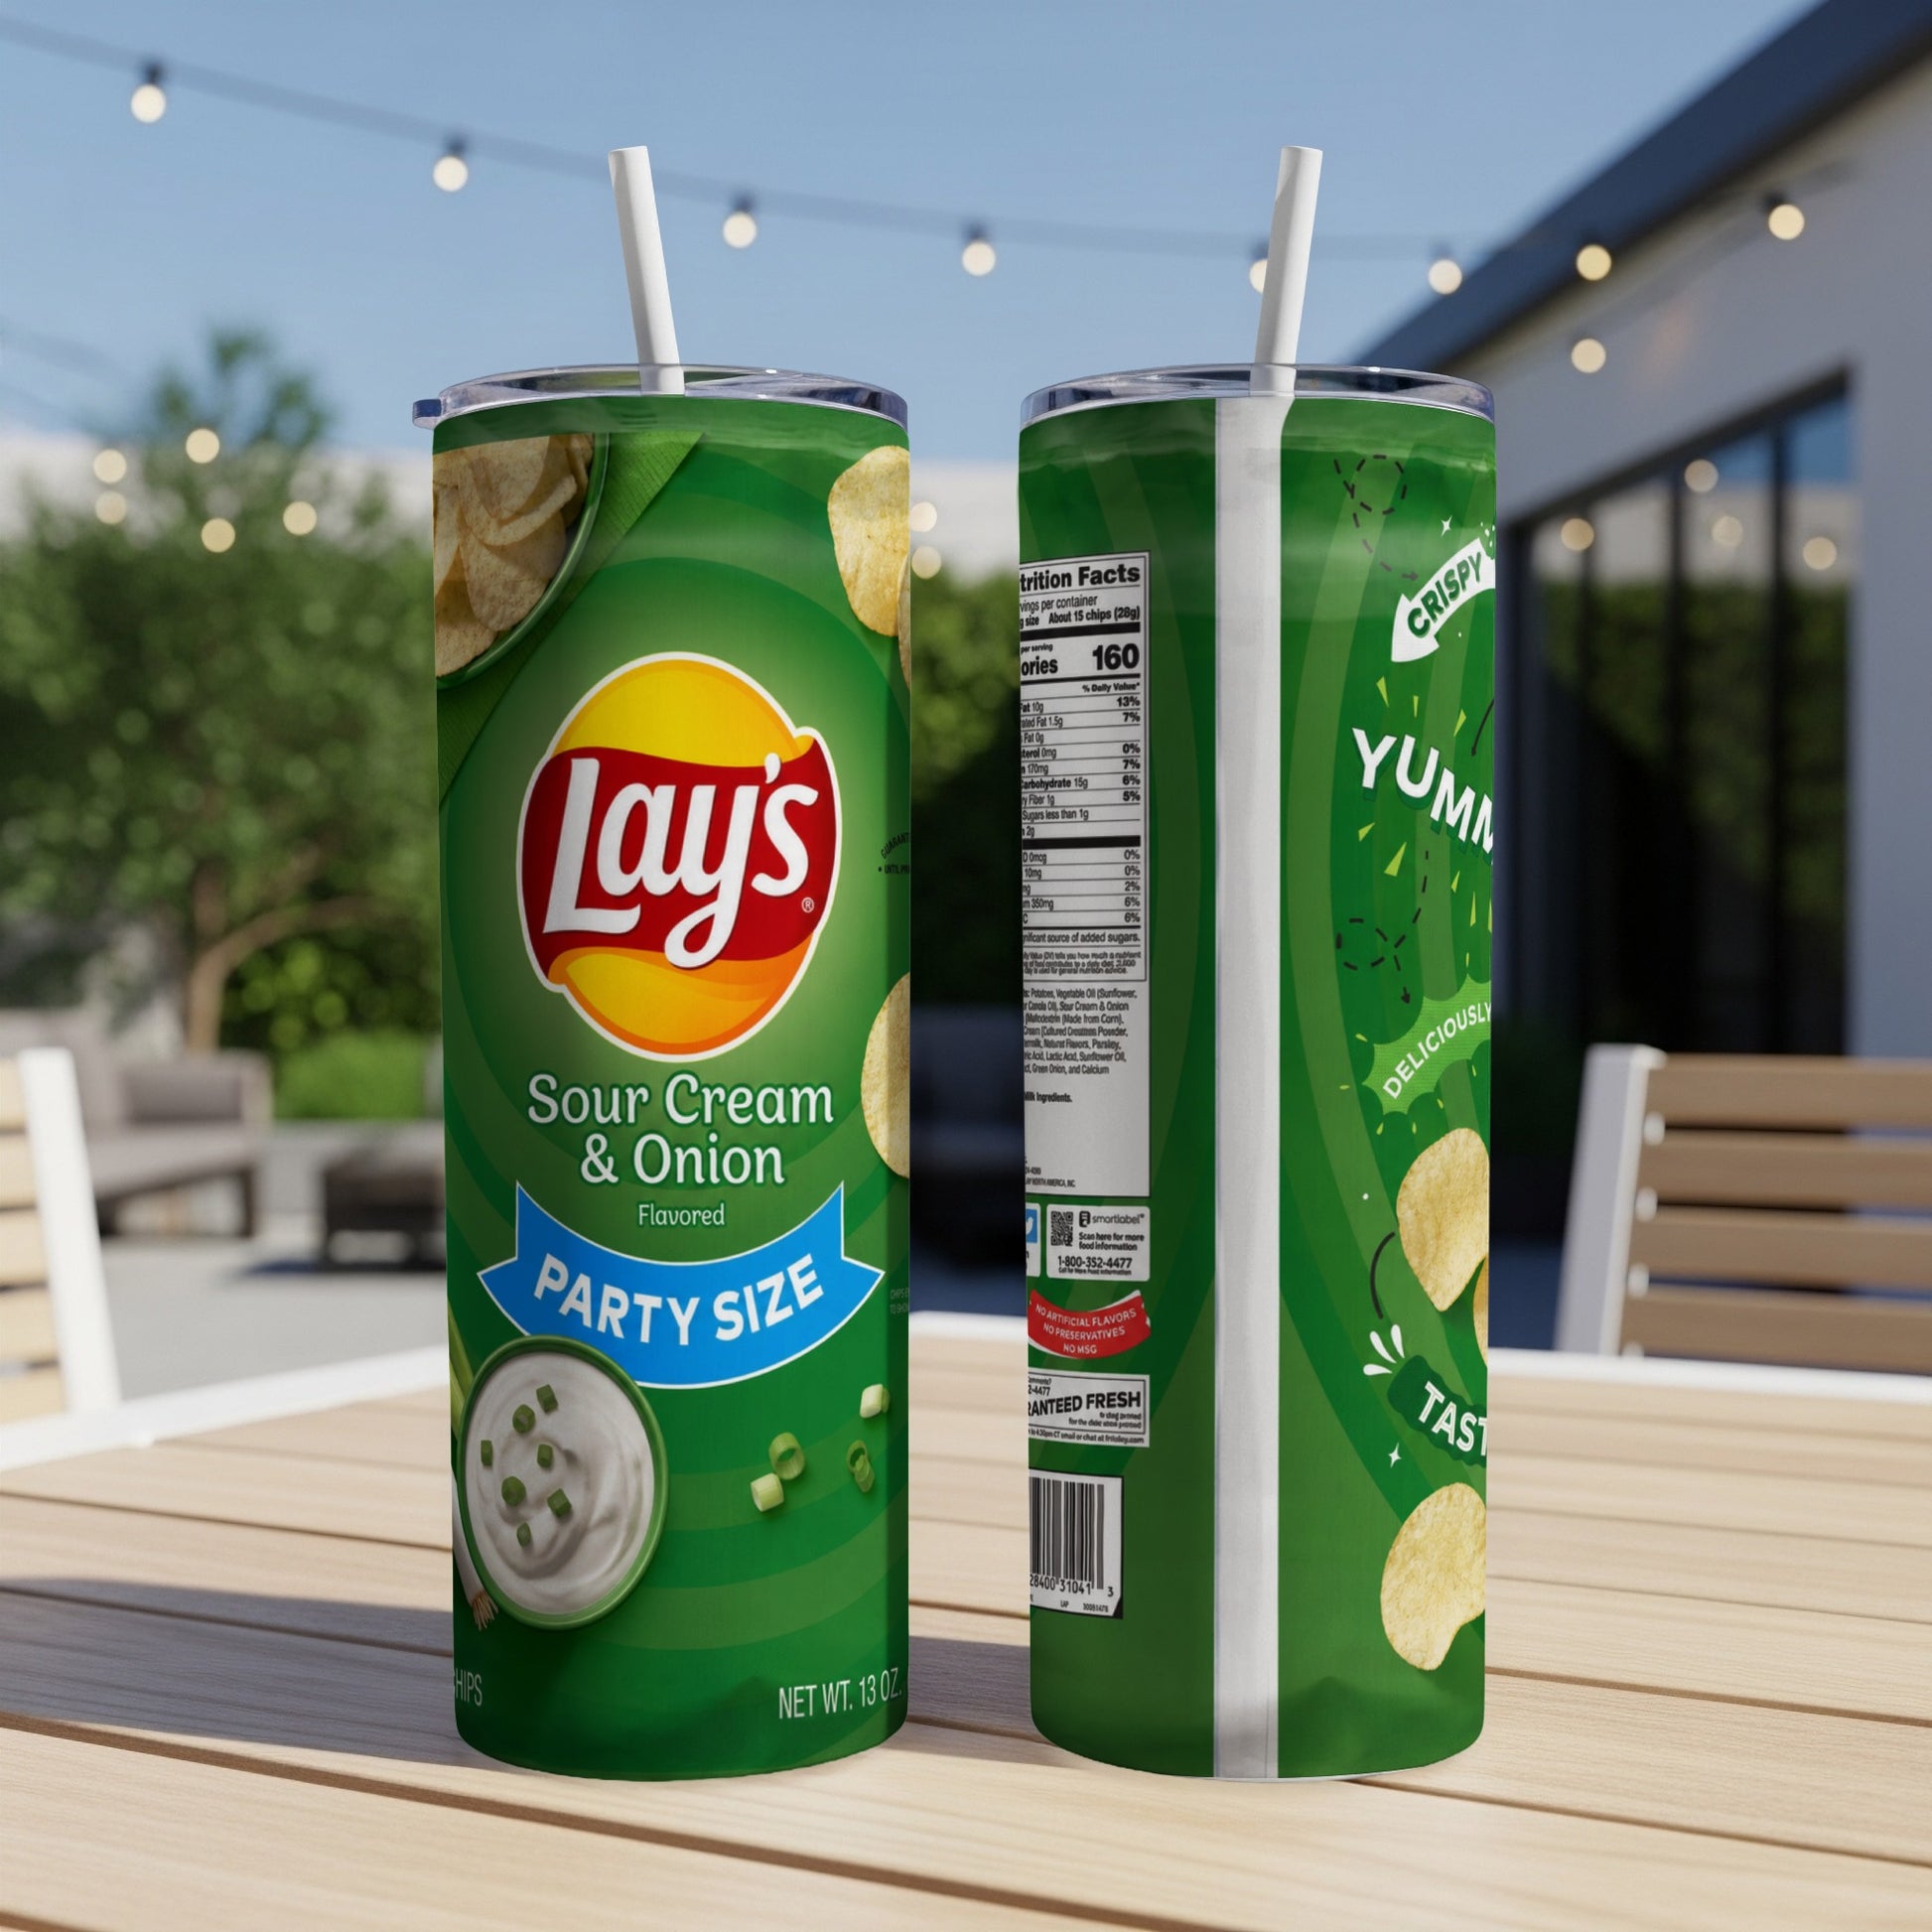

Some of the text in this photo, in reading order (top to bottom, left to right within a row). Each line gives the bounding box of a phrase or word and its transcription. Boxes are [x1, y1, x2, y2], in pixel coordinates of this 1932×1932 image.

[1021, 564, 1141, 592] trition Facts
[1407, 551, 1482, 639] CRISPY
[1041, 601, 1054, 613] per
[1056, 595, 1097, 609] container
[1026, 616, 1039, 626] size
[1049, 613, 1071, 623] About
[1074, 611, 1083, 621] 15
[1086, 608, 1111, 622] chips
[1114, 607, 1140, 621] (28g)
[1022, 643, 1140, 675] ories 160
[1033, 702, 1043, 713] 10g
[1117, 696, 1140, 707] 13%
[1036, 717, 1046, 727] Fat
[1048, 716, 1062, 728] 1.5g
[1123, 712, 1140, 723] 7%
[1025, 733, 1043, 744] Fat 0g
[1041, 748, 1056, 760] 0mg
[1123, 744, 1140, 754] 0%
[1028, 763, 1048, 775] 170mg
[1123, 759, 1140, 769] 7%
[1074, 777, 1088, 789] 15g
[1123, 775, 1140, 785] 6%
[1047, 794, 1054, 806] 1g
[1123, 790, 1140, 801] 5%
[1023, 809, 1088, 822] Sugars less than 1g
[1027, 826, 1035, 837] 2g
[543, 753, 818, 968] Lay's
[1124, 850, 1140, 860] 0%
[1025, 866, 1140, 879] 10mg 0%
[1125, 882, 1140, 892] 2%
[1032, 898, 1053, 910] 350mg
[1125, 897, 1140, 907] 6%
[1125, 912, 1140, 922] 6%
[1047, 933, 1070, 942] source
[1071, 932, 1078, 942] of
[1080, 932, 1106, 941] added
[1108, 933, 1140, 944] sugars.
[1106, 1002, 1129, 1011] Onion
[1383, 1002, 1491, 1100] DELICIOUSLY
[1081, 1064, 1109, 1074] Calcium
[528, 1073, 834, 1125] Sour Cream
[1036, 1092, 1072, 1103] Ingredients.
[581, 1133, 785, 1184] & Onion
[638, 1202, 725, 1226] Flavored
[1057, 1256, 1132, 1269] 1-800-352-4477
[533, 1253, 824, 1346] PARTY SIZE
[1035, 1304, 1137, 1326] NO ARTIFICIAL FLAVORS
[1043, 1323, 1125, 1340] NO PRESERVATIVES
[1063, 1343, 1097, 1354] NO MSG
[1086, 1391, 1141, 1409] FRESH
[1418, 1380, 1487, 1456] TAST
[1031, 1575, 1114, 1596] 28400 31041 3
[456, 1668, 483, 1707] HIPS
[779, 1685, 817, 1719] NET
[822, 1679, 853, 1714] WT.
[859, 1674, 877, 1707] 13
